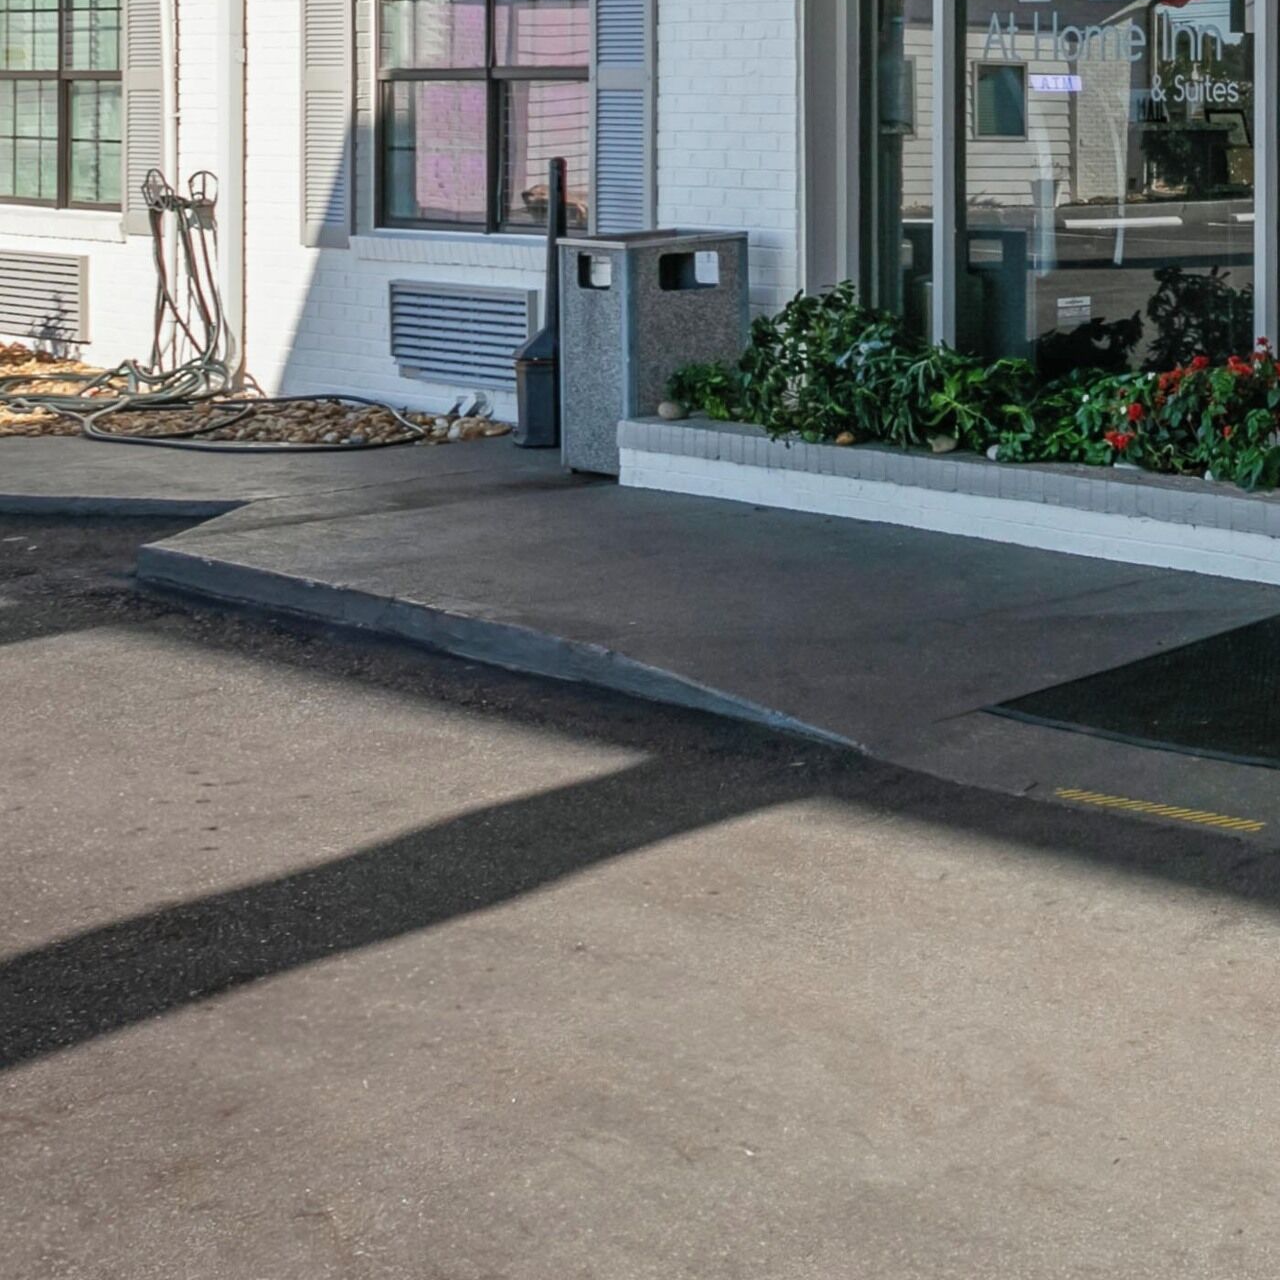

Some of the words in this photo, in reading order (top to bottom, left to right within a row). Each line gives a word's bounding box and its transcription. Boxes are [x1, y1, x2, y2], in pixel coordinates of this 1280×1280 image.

[983, 11, 1021, 61] At
[1033, 10, 1146, 62] Home
[1162, 8, 1222, 61] Inn
[1151, 73, 1166, 102] &
[1173, 75, 1239, 103] Suites
